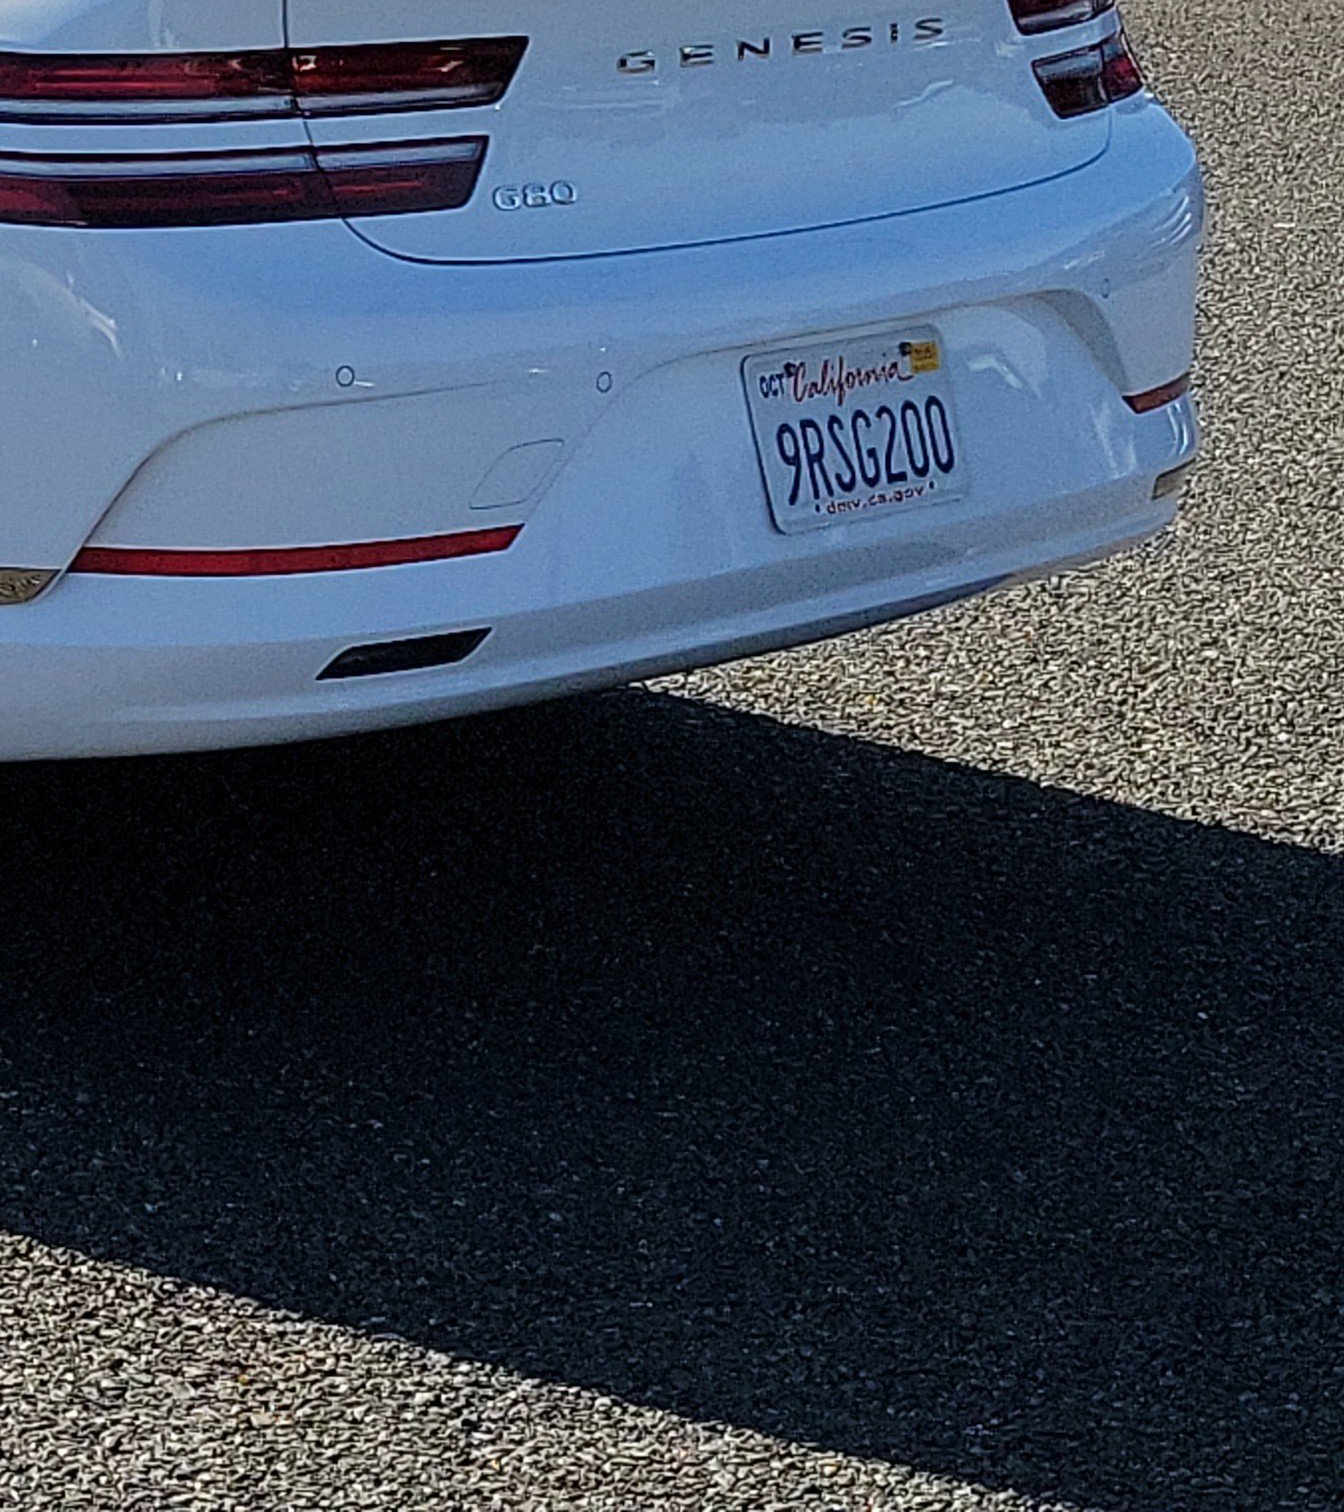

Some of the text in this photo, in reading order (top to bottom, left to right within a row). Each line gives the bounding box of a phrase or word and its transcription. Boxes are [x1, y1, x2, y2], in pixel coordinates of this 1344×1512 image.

[616, 16, 945, 74] GENESIS
[759, 373, 784, 399] OCT
[792, 355, 914, 407] California
[775, 395, 955, 507] 9RSG200
[826, 485, 924, 515] dmv.ca.gov
